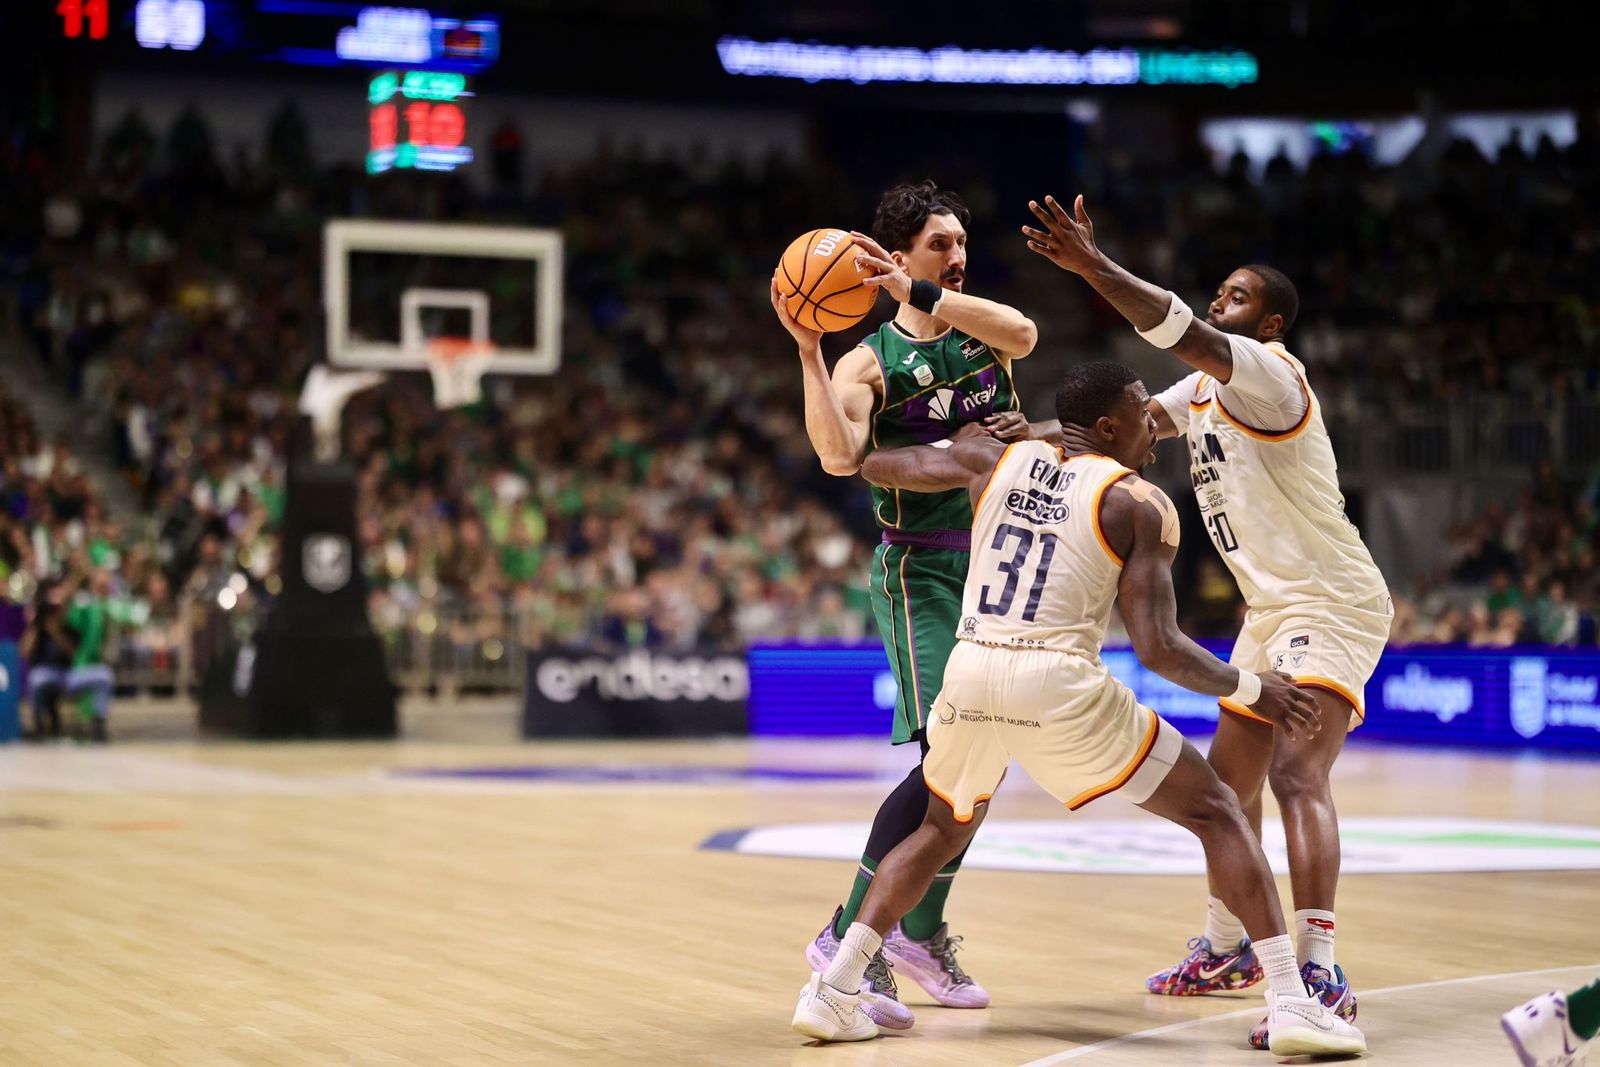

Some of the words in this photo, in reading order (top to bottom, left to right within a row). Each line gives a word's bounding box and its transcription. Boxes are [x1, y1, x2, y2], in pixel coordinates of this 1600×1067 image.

[1208, 511, 1239, 553] 0
[977, 523, 1058, 622] 31
[536, 649, 751, 703] endesa
[994, 715, 1006, 723] DE
[1007, 718, 1041, 728] MURCIA
